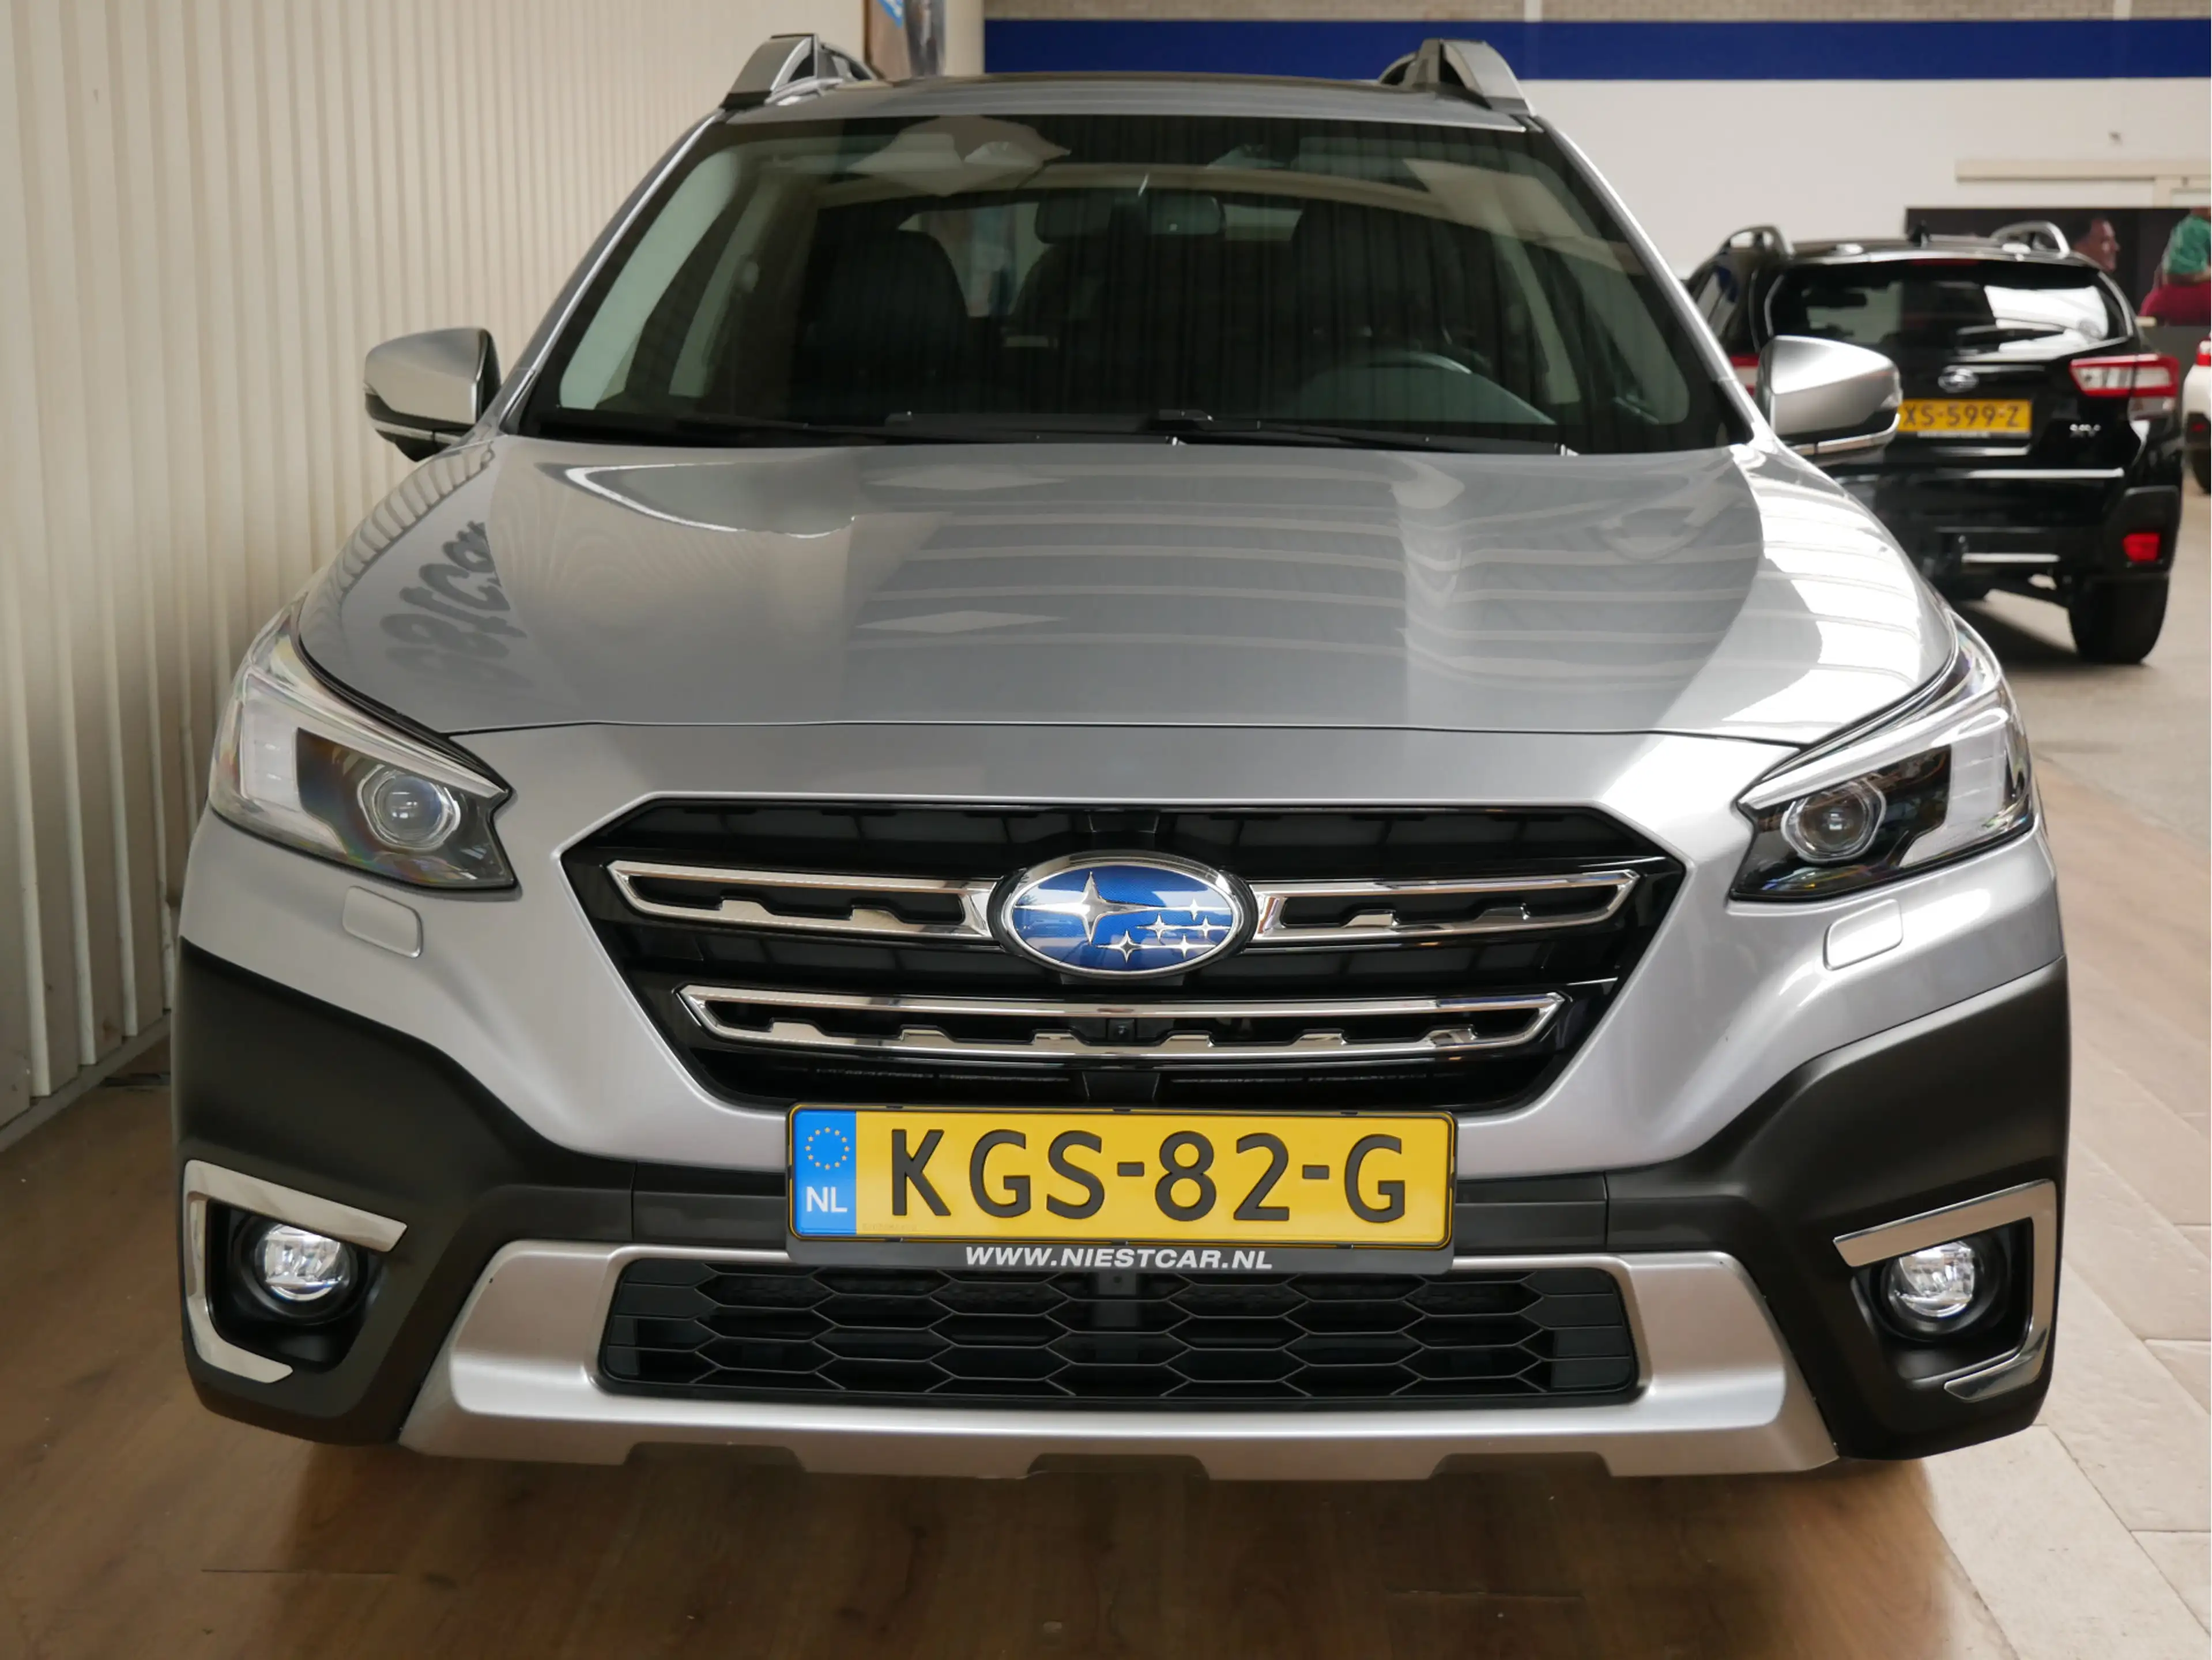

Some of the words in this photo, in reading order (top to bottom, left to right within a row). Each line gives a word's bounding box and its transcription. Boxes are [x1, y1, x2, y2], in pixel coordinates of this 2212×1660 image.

[891, 1128, 1406, 1224] KGS-82-G
[806, 1186, 848, 1213] NL
[966, 1246, 1273, 1270] WWW.NIESTCAR.NL
